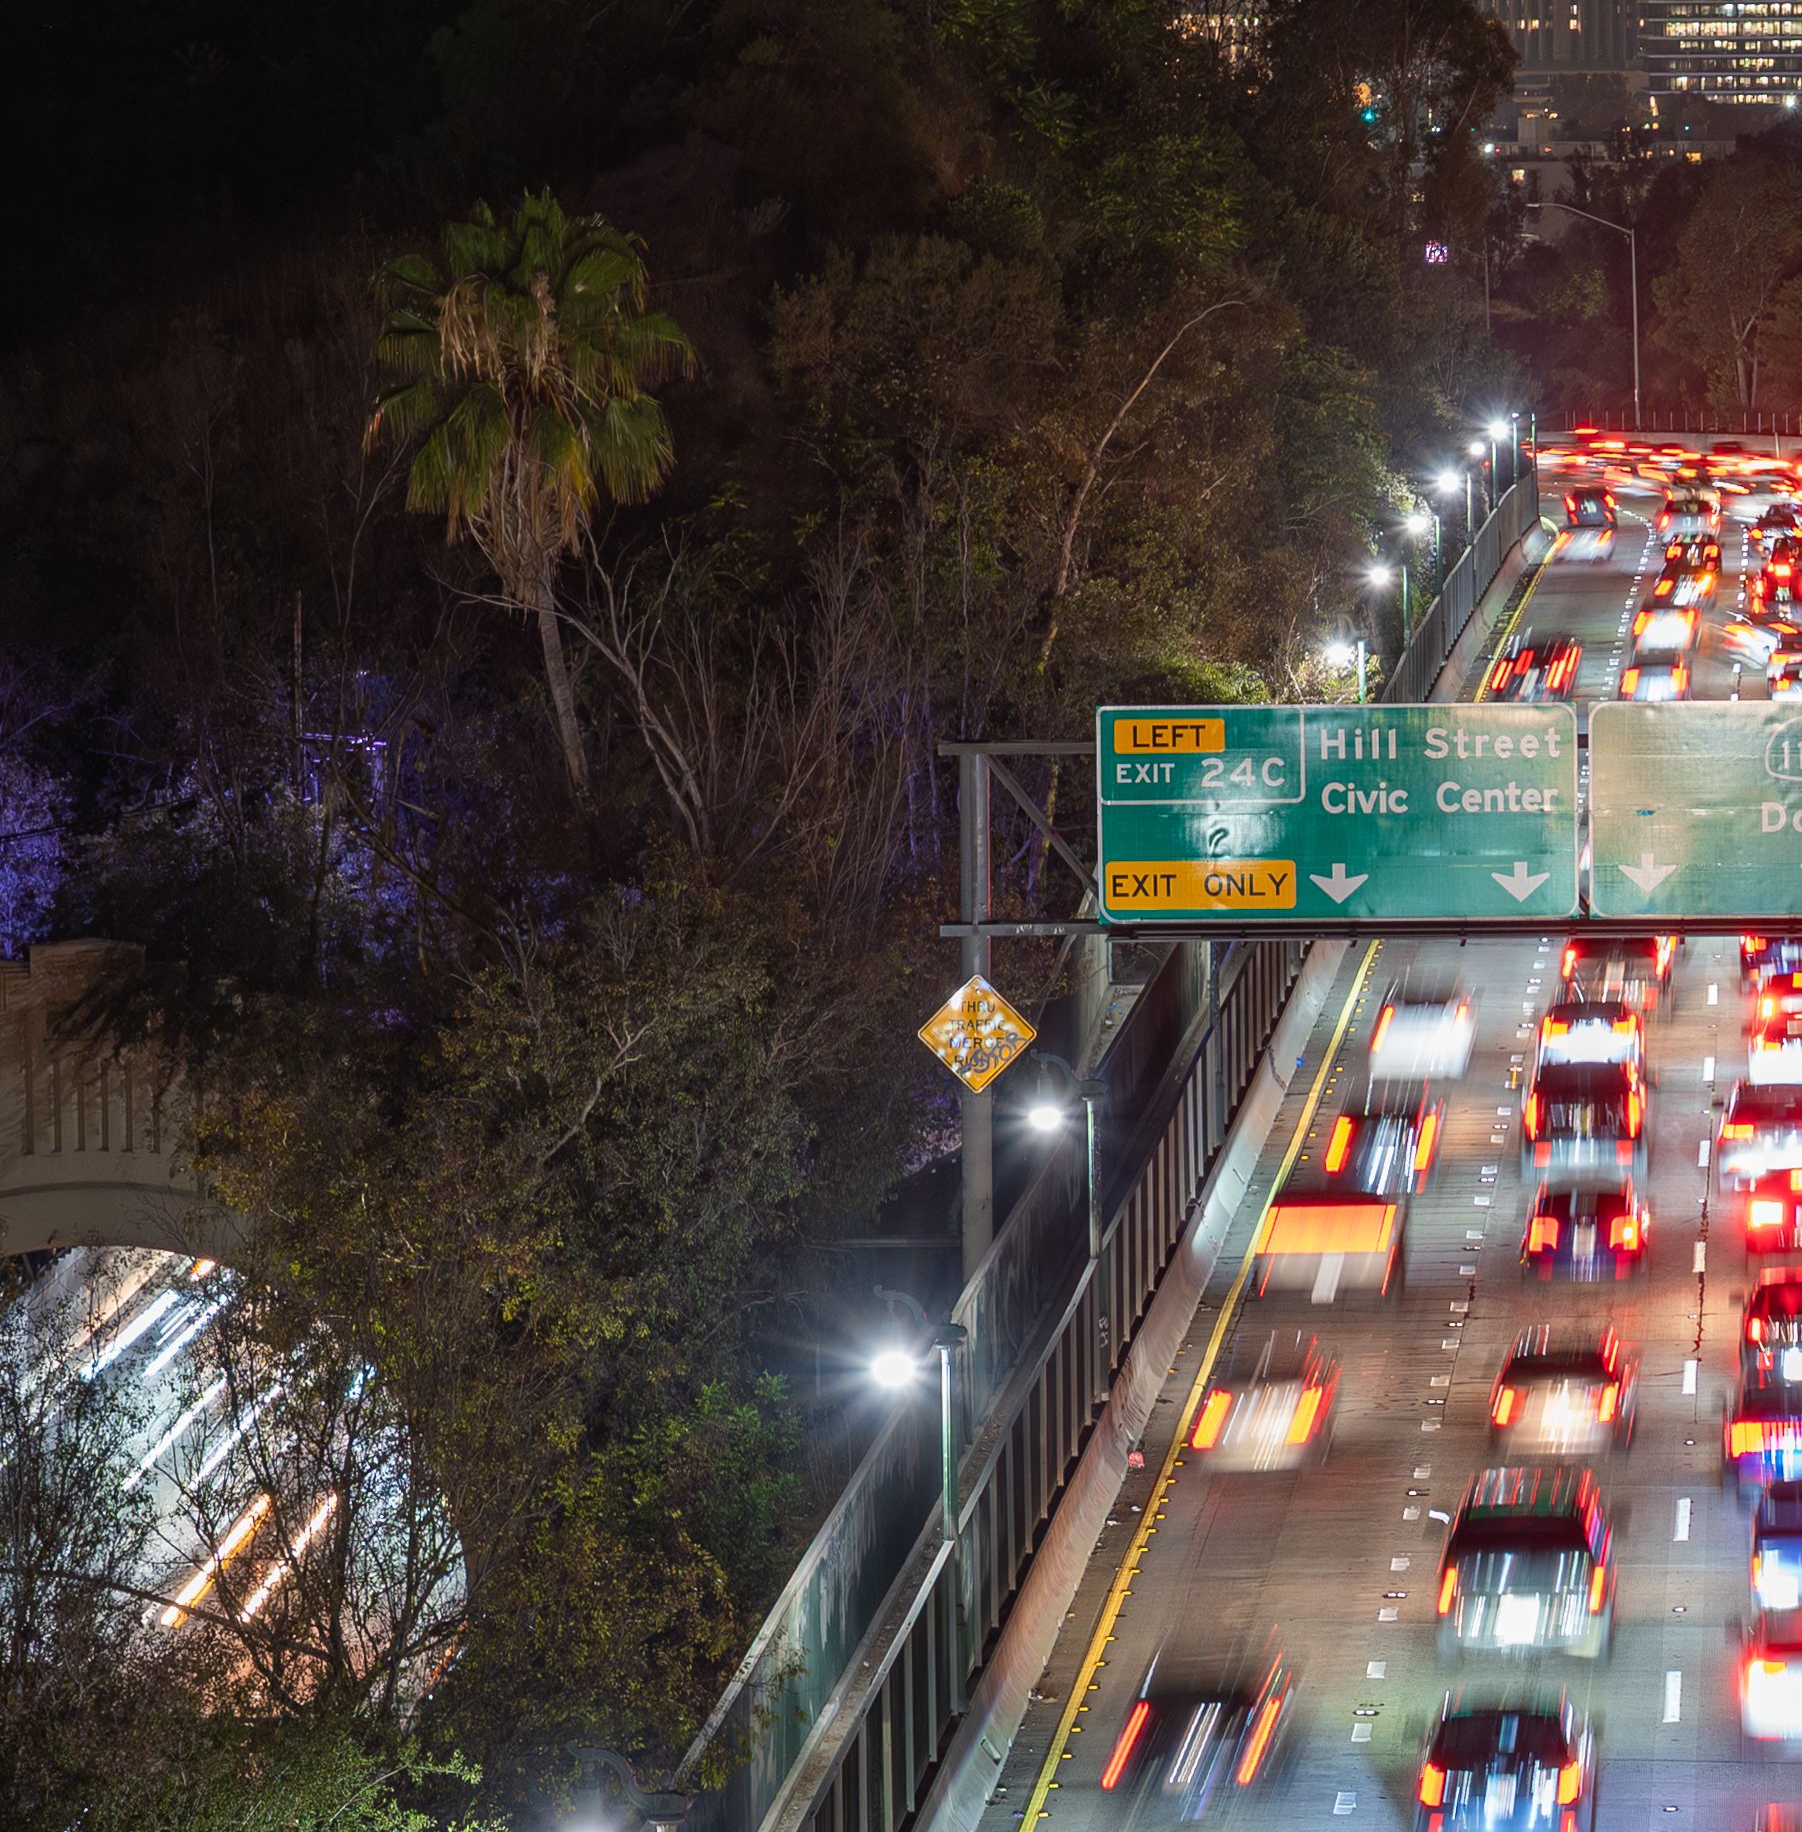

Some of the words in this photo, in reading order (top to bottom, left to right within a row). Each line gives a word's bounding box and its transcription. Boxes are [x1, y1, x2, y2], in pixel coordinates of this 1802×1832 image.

[1132, 724, 1206, 748] LEFT
[1320, 728, 1397, 760] Hill
[1423, 727, 1561, 759] Street
[1116, 763, 1176, 784] EXIT
[1200, 757, 1286, 788] 24C
[1321, 781, 1409, 815] Civic
[1435, 780, 1560, 813] Center
[1111, 874, 1177, 898] EXIT
[1204, 873, 1289, 897] ONLY
[961, 1000, 996, 1013] THRU
[949, 1037, 1005, 1049] MERGE
